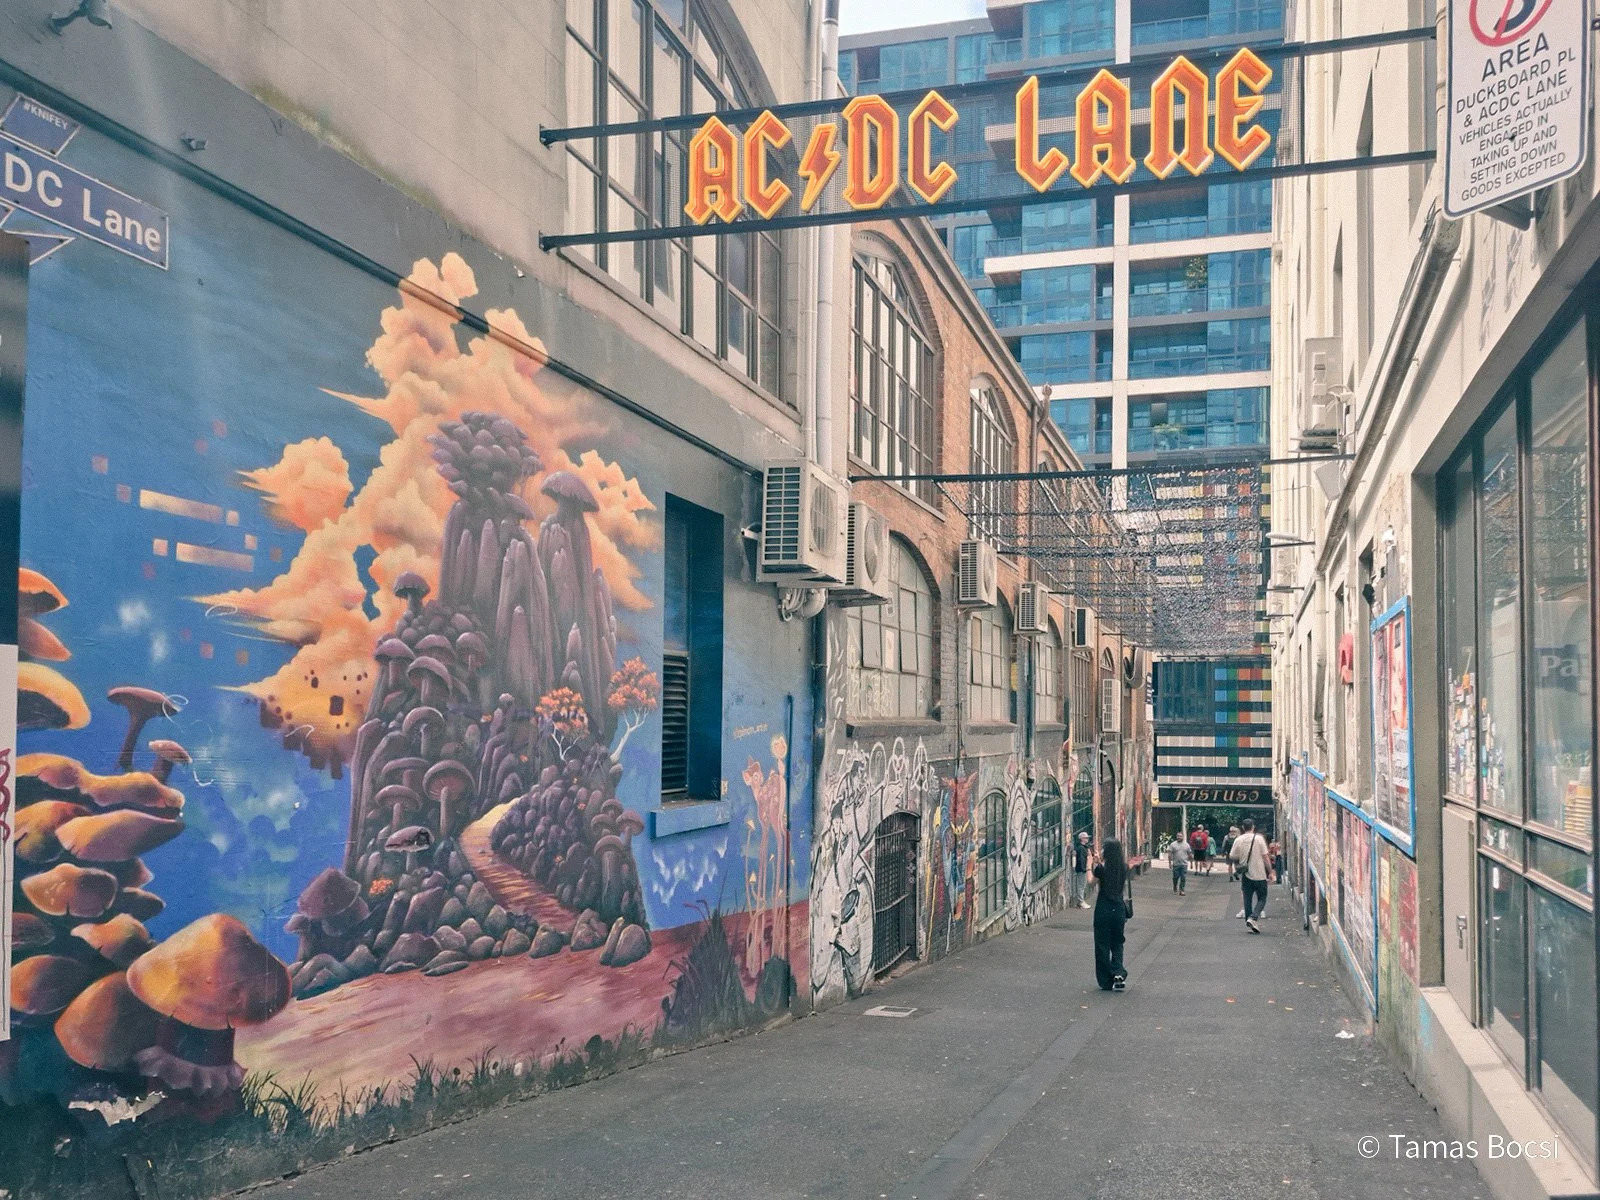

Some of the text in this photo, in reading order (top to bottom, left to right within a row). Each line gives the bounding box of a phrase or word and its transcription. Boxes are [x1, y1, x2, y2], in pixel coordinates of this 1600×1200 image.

[1456, 47, 1576, 114] DUCKBOARD PL
[1482, 32, 1549, 82] AREA
[24, 102, 68, 130] #KNIFEY
[1016, 47, 1273, 193] LANE
[1459, 87, 1572, 145] VEHICLES ACTUALLY
[1464, 69, 1567, 128] & ACDC LANE
[1471, 125, 1558, 169] TAKING UP AND
[1479, 113, 1549, 151] ENGAGED IN
[1461, 152, 1565, 201] GOODS EXCEPTED
[1470, 140, 1557, 184] SETTING DOWN
[5, 151, 161, 252] DC Lane
[1173, 788, 1260, 802] PASTUSO
